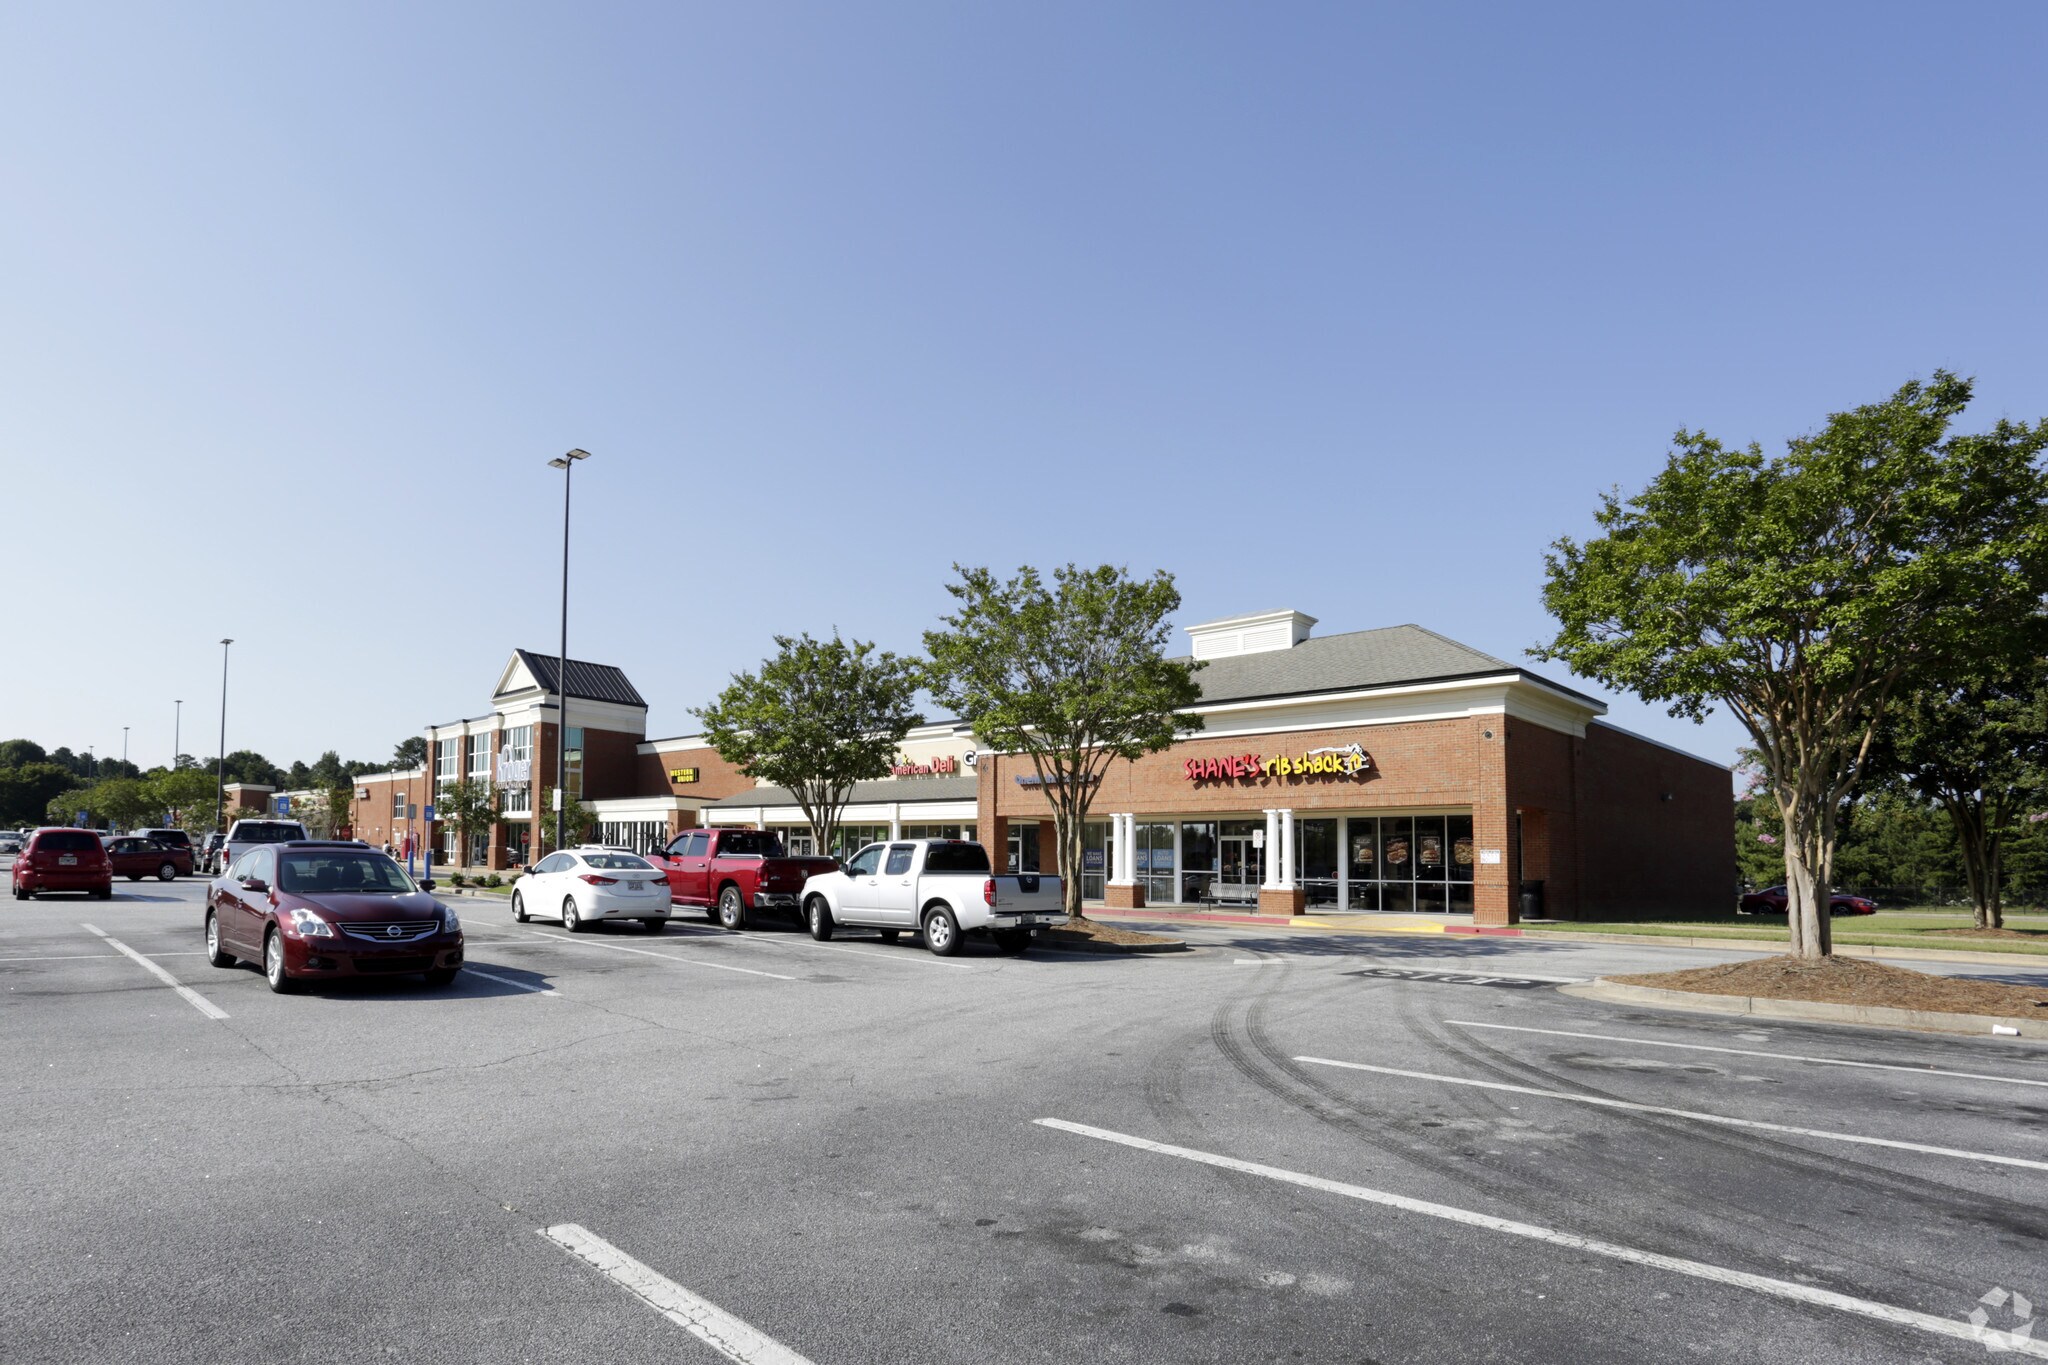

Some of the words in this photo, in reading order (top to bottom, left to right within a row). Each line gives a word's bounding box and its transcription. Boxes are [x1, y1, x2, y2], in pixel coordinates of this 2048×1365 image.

[931, 756, 954, 773] Deli
[1183, 754, 1261, 780] SHANE'S
[1266, 754, 1291, 777] rib
[1293, 751, 1344, 775] shack
[670, 768, 694, 777] WESTERN
[677, 775, 694, 783] UNION
[1364, 970, 1532, 985] STOP
